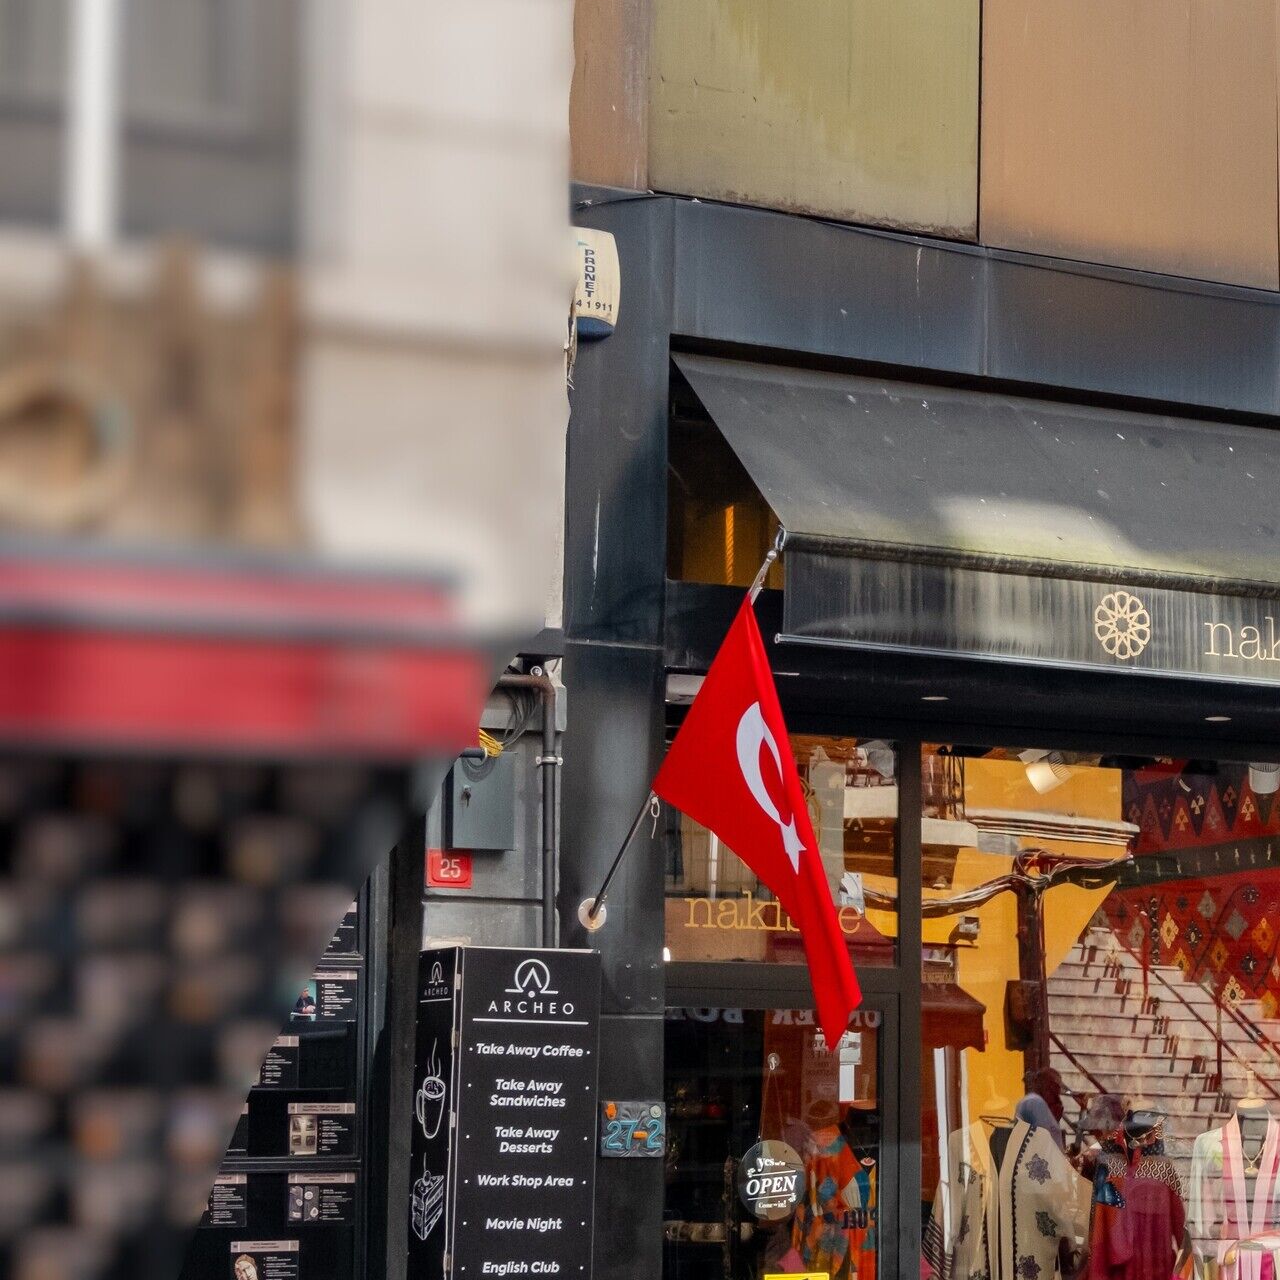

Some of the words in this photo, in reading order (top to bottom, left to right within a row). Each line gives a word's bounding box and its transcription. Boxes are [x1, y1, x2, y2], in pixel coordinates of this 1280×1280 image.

[584, 248, 595, 297] PRONET
[440, 858, 461, 878] 25
[684, 890, 864, 934] nakie
[488, 1000, 575, 1015] ARCHEO
[476, 1043, 505, 1055] Take
[506, 1044, 541, 1058] Away
[542, 1045, 584, 1057] Coffee
[496, 1079, 525, 1091] Take
[526, 1080, 563, 1094] Away
[490, 1094, 566, 1107] Sandwiches
[494, 1126, 524, 1139] Take
[524, 1127, 560, 1141] Away
[605, 1119, 662, 1149] 27-2
[499, 1141, 553, 1153] Desserts
[756, 1157, 775, 1172] yes
[477, 1175, 509, 1186] Work
[511, 1175, 543, 1188] Shop
[544, 1175, 574, 1186] Area
[746, 1175, 797, 1195] OPEN
[485, 1218, 524, 1229] Movie
[526, 1218, 563, 1232] Night
[482, 1262, 529, 1276] English
[530, 1262, 560, 1273] Club
